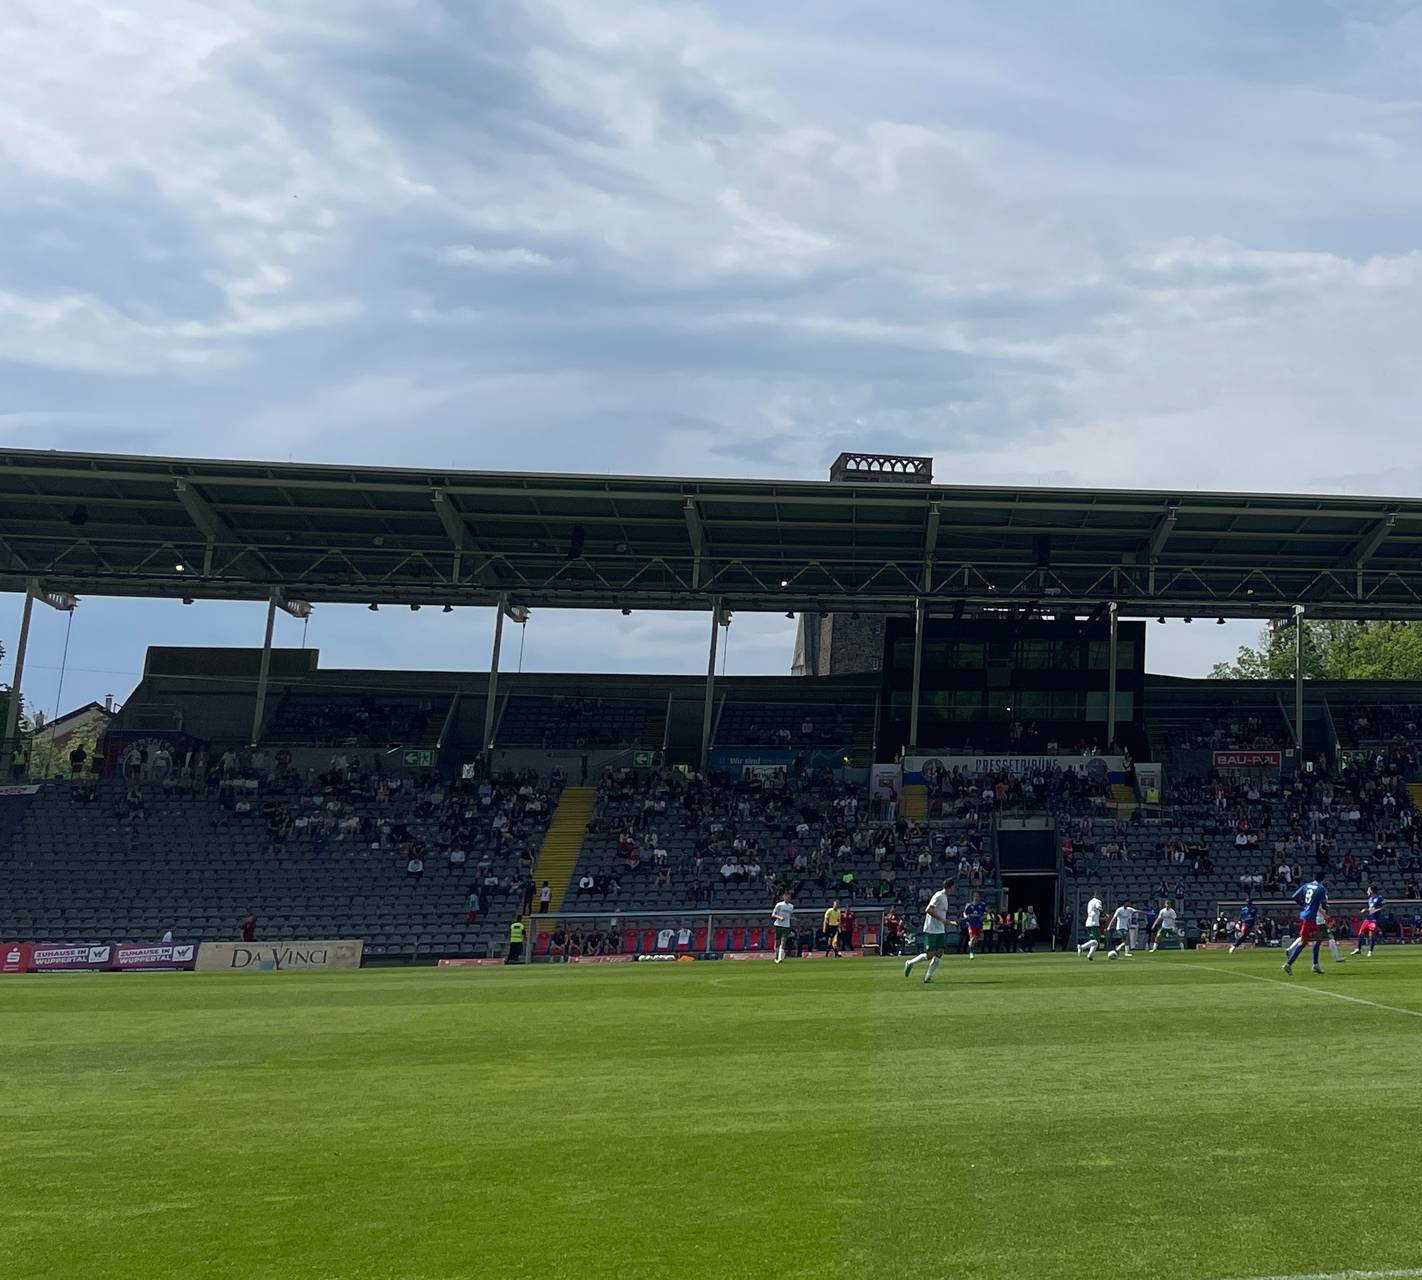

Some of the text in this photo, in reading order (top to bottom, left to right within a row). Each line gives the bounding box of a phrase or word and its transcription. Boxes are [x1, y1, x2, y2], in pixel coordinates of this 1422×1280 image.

[36, 948, 87, 958] ZUHAUSE IN
[119, 948, 171, 958] ZUHAUSE IN
[272, 947, 328, 968] VINCI
[35, 956, 88, 965] WUPPERTAL
[119, 956, 172, 965] WUPPERTAL
